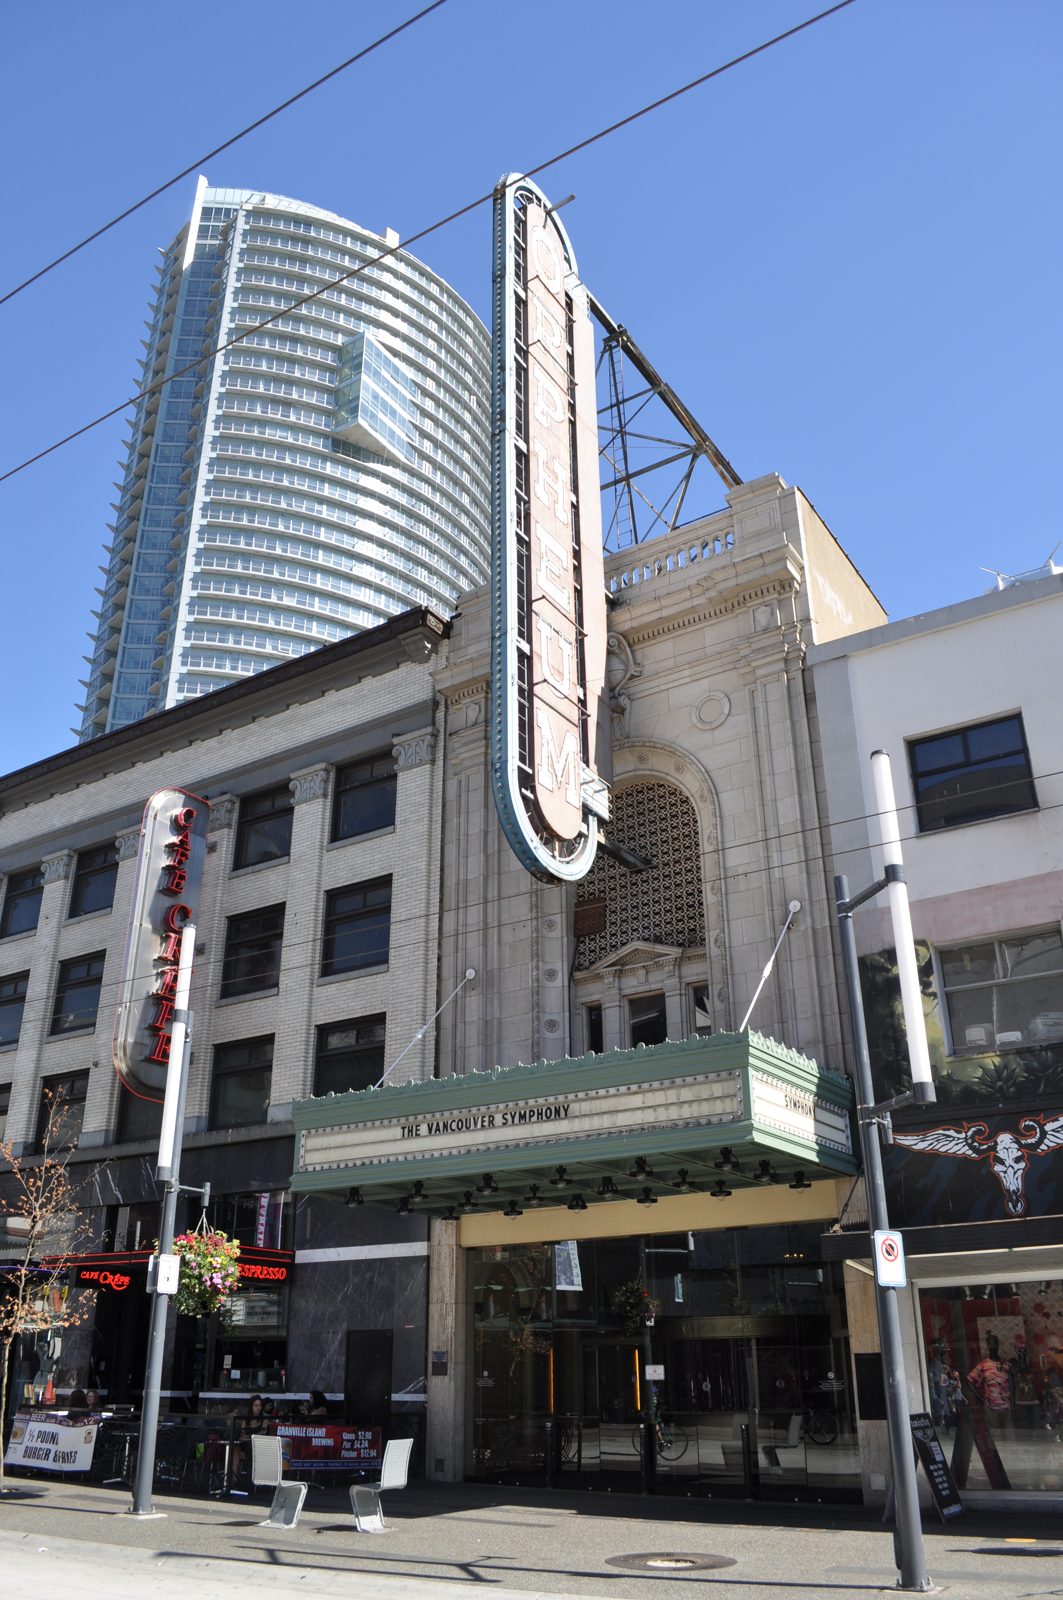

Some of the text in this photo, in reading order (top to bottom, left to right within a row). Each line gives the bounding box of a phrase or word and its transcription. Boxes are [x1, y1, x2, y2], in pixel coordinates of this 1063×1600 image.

[529, 224, 581, 811] ORPHEUM
[400, 1104, 571, 1138] THE VANCOUVER SYMPHONY
[237, 1263, 287, 1280] ESPRESSO
[30, 1413, 46, 1421] BEER
[277, 1426, 326, 1437] GRANVILLE ISLAND
[312, 1438, 334, 1447] BREWING
[23, 1446, 51, 1461] BURGER
